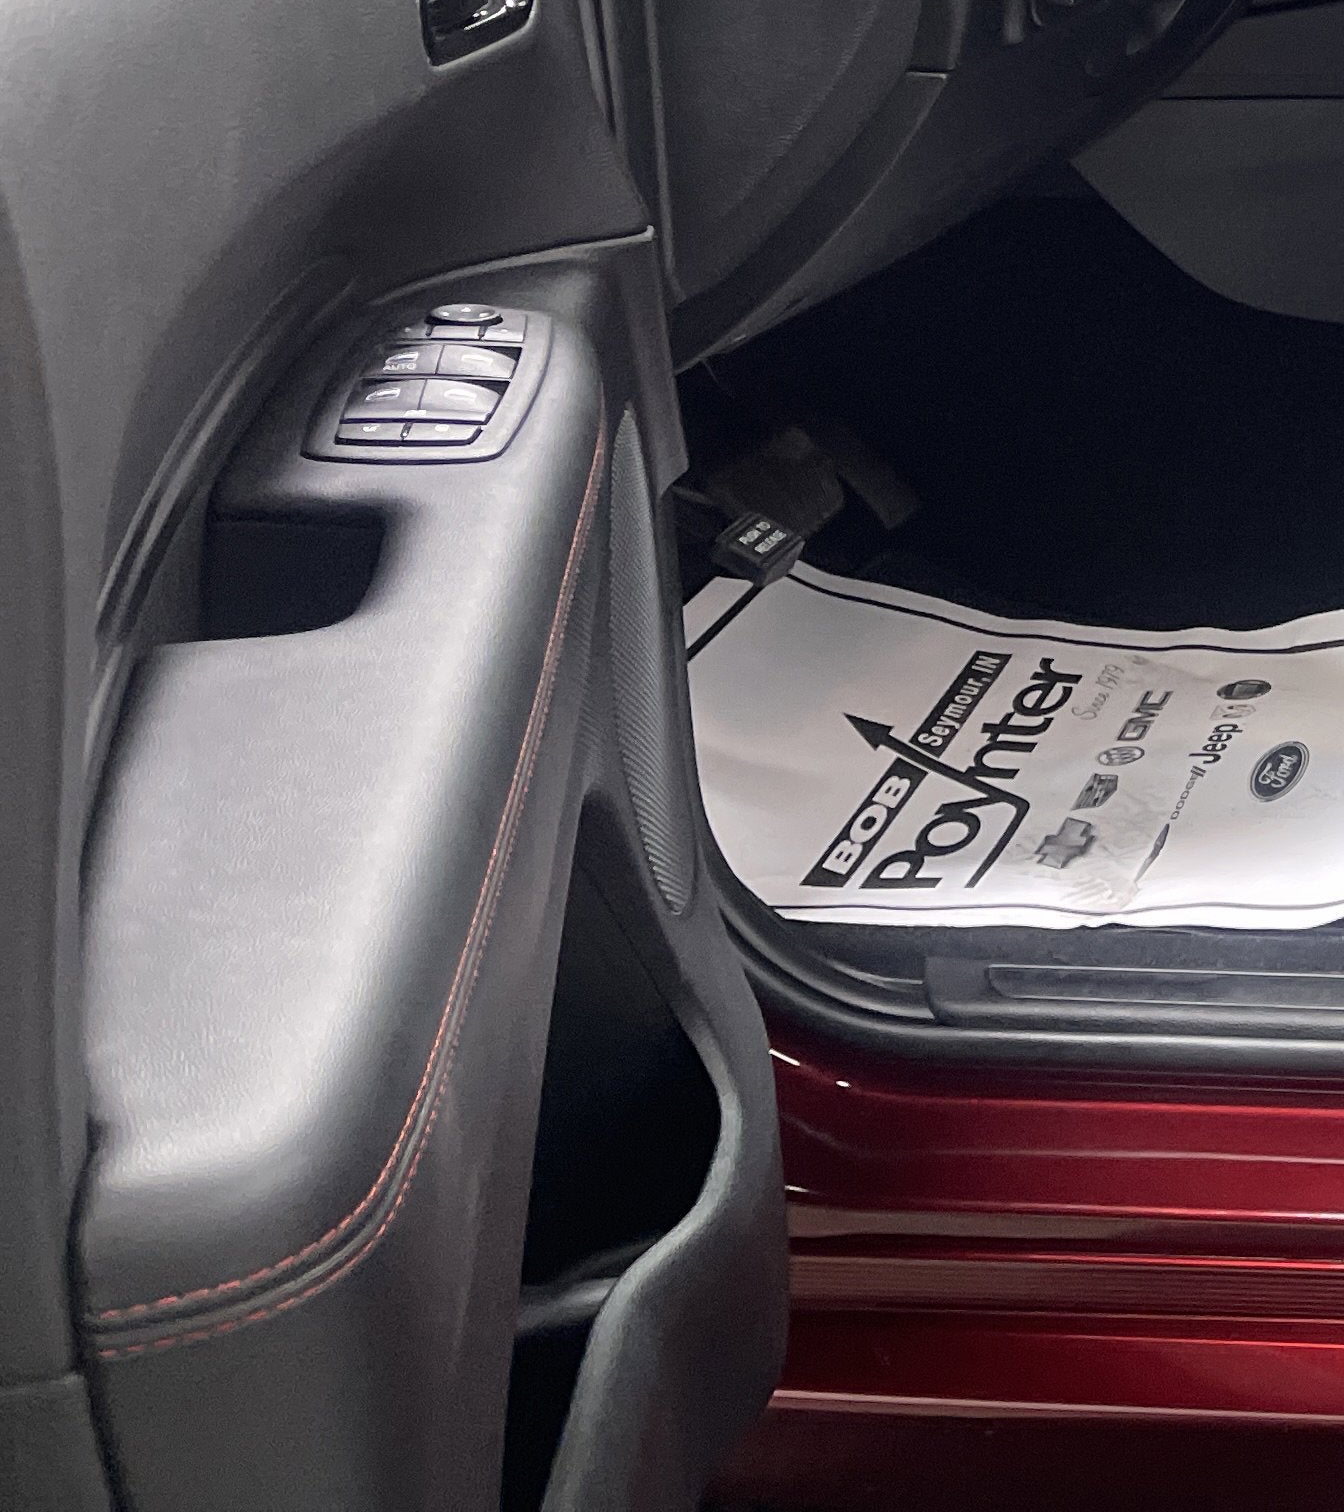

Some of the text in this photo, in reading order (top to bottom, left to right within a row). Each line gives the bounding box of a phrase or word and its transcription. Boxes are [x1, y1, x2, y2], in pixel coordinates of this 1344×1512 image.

[917, 654, 1001, 748] Seymour, IN
[1116, 690, 1174, 742] GMC
[1188, 722, 1243, 765] Jeep
[1258, 753, 1299, 789] Ford
[822, 774, 912, 875] BOB
